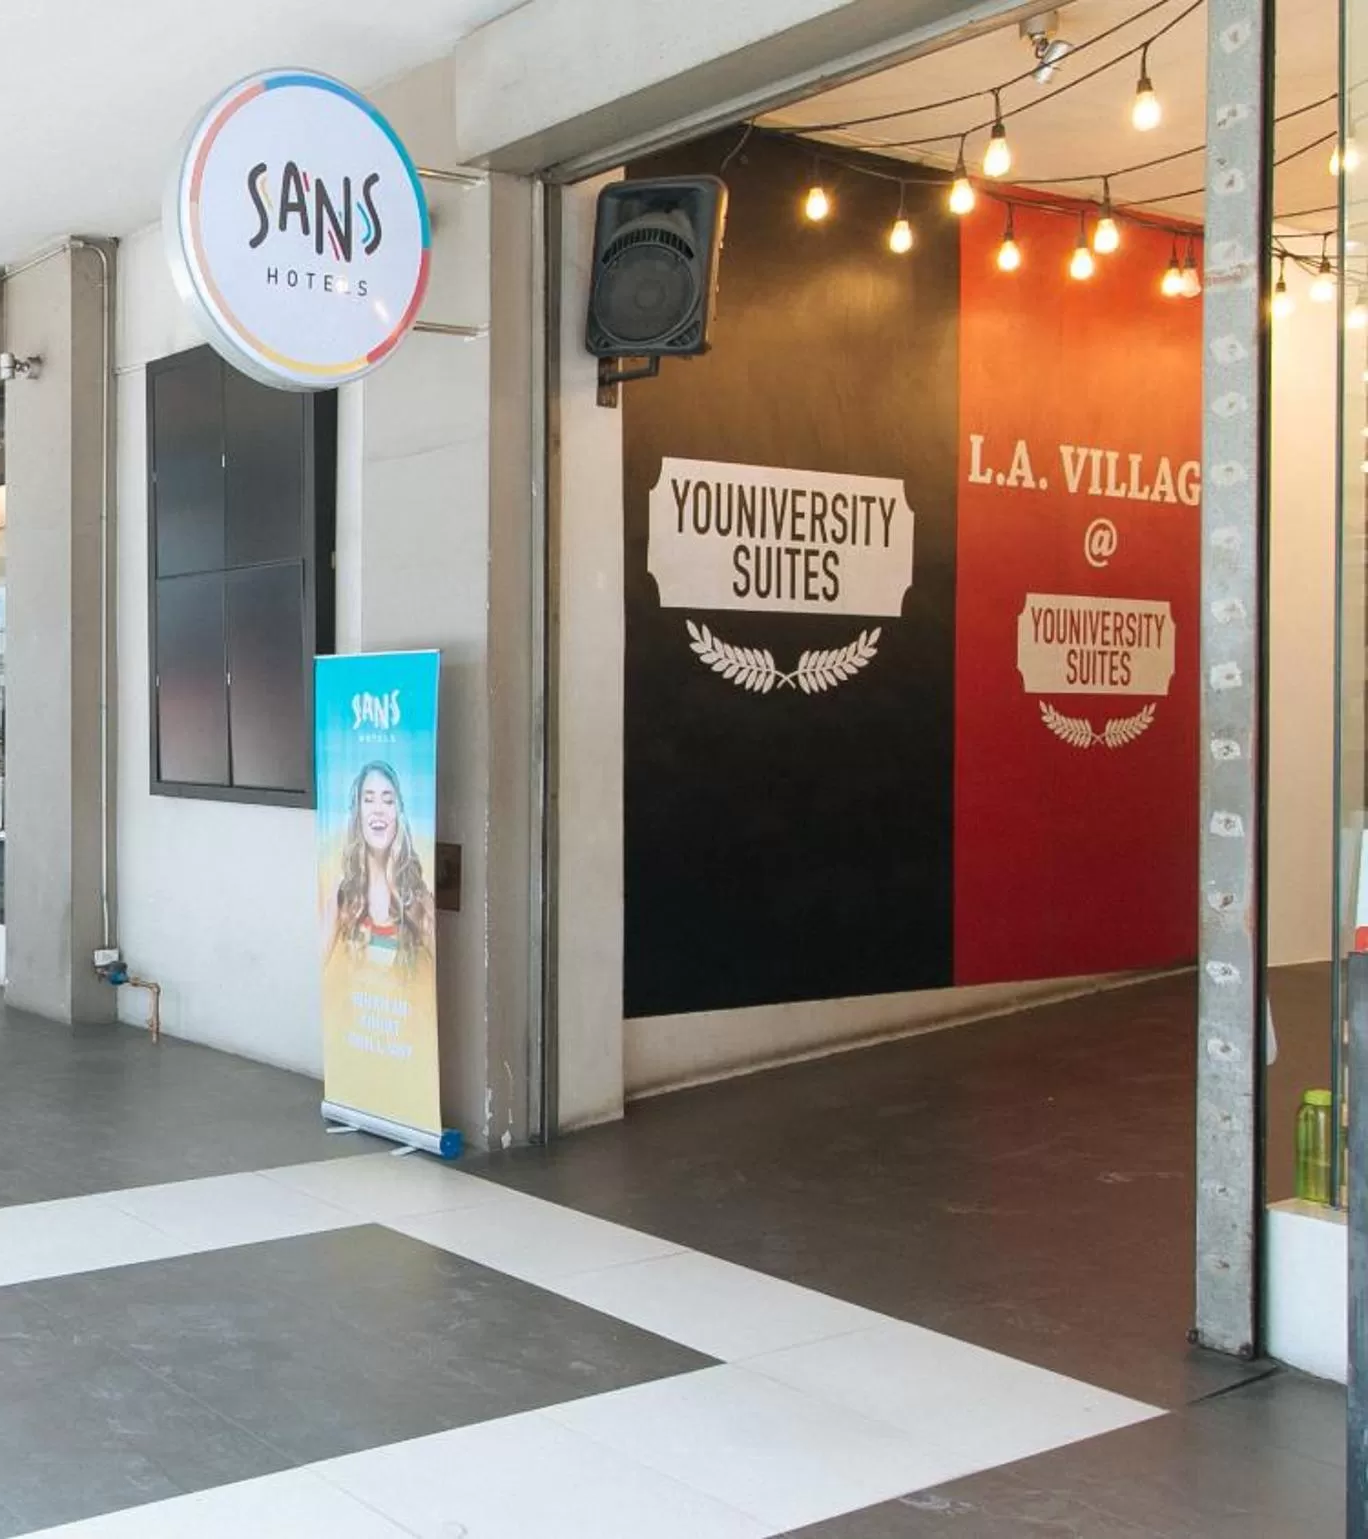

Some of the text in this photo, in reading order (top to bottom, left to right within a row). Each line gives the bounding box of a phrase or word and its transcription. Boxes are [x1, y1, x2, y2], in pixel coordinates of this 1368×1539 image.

[247, 160, 383, 263] SANS
[266, 266, 369, 297] HOTES
[967, 433, 1048, 491] L.A.
[670, 478, 897, 549] YOUNIVERSITY
[1083, 518, 1118, 567] @
[731, 545, 840, 602] SUITES
[1030, 606, 1166, 649] YOUNIVERSITY
[1065, 648, 1131, 687] SUITES
[351, 689, 401, 730] SANS
